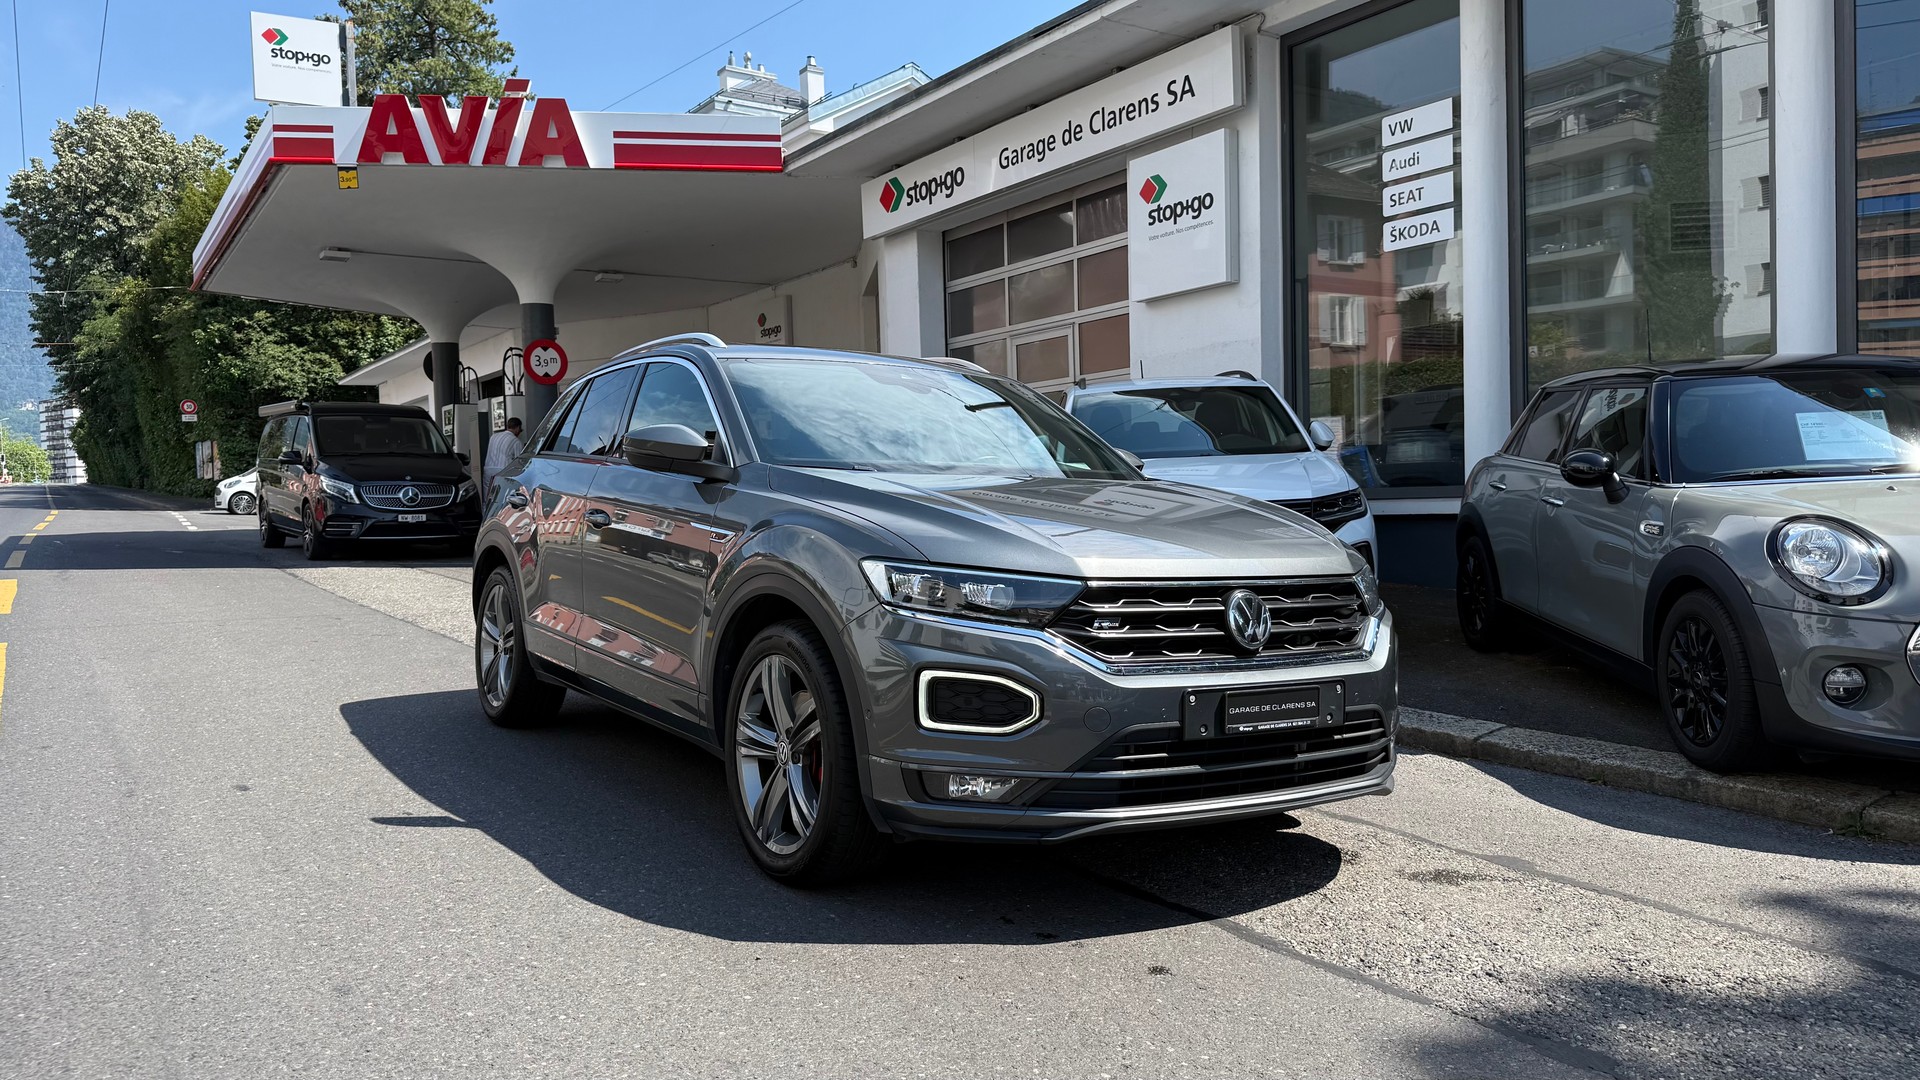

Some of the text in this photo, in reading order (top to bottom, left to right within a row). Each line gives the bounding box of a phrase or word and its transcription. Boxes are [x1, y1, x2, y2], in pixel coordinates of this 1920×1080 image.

[270, 46, 331, 67] stop+go
[998, 74, 1196, 170] Garage de Clarens SA
[1388, 117, 1414, 137] VW
[1388, 151, 1420, 173] Audi
[906, 166, 965, 205] stop+go
[1389, 186, 1425, 208] SEAT
[1147, 192, 1214, 226] stop+go
[1390, 219, 1441, 243] ŠKODA
[1229, 705, 1261, 714] GARAGE
[1261, 704, 1271, 712] DE
[1272, 702, 1306, 711] CLARENS
